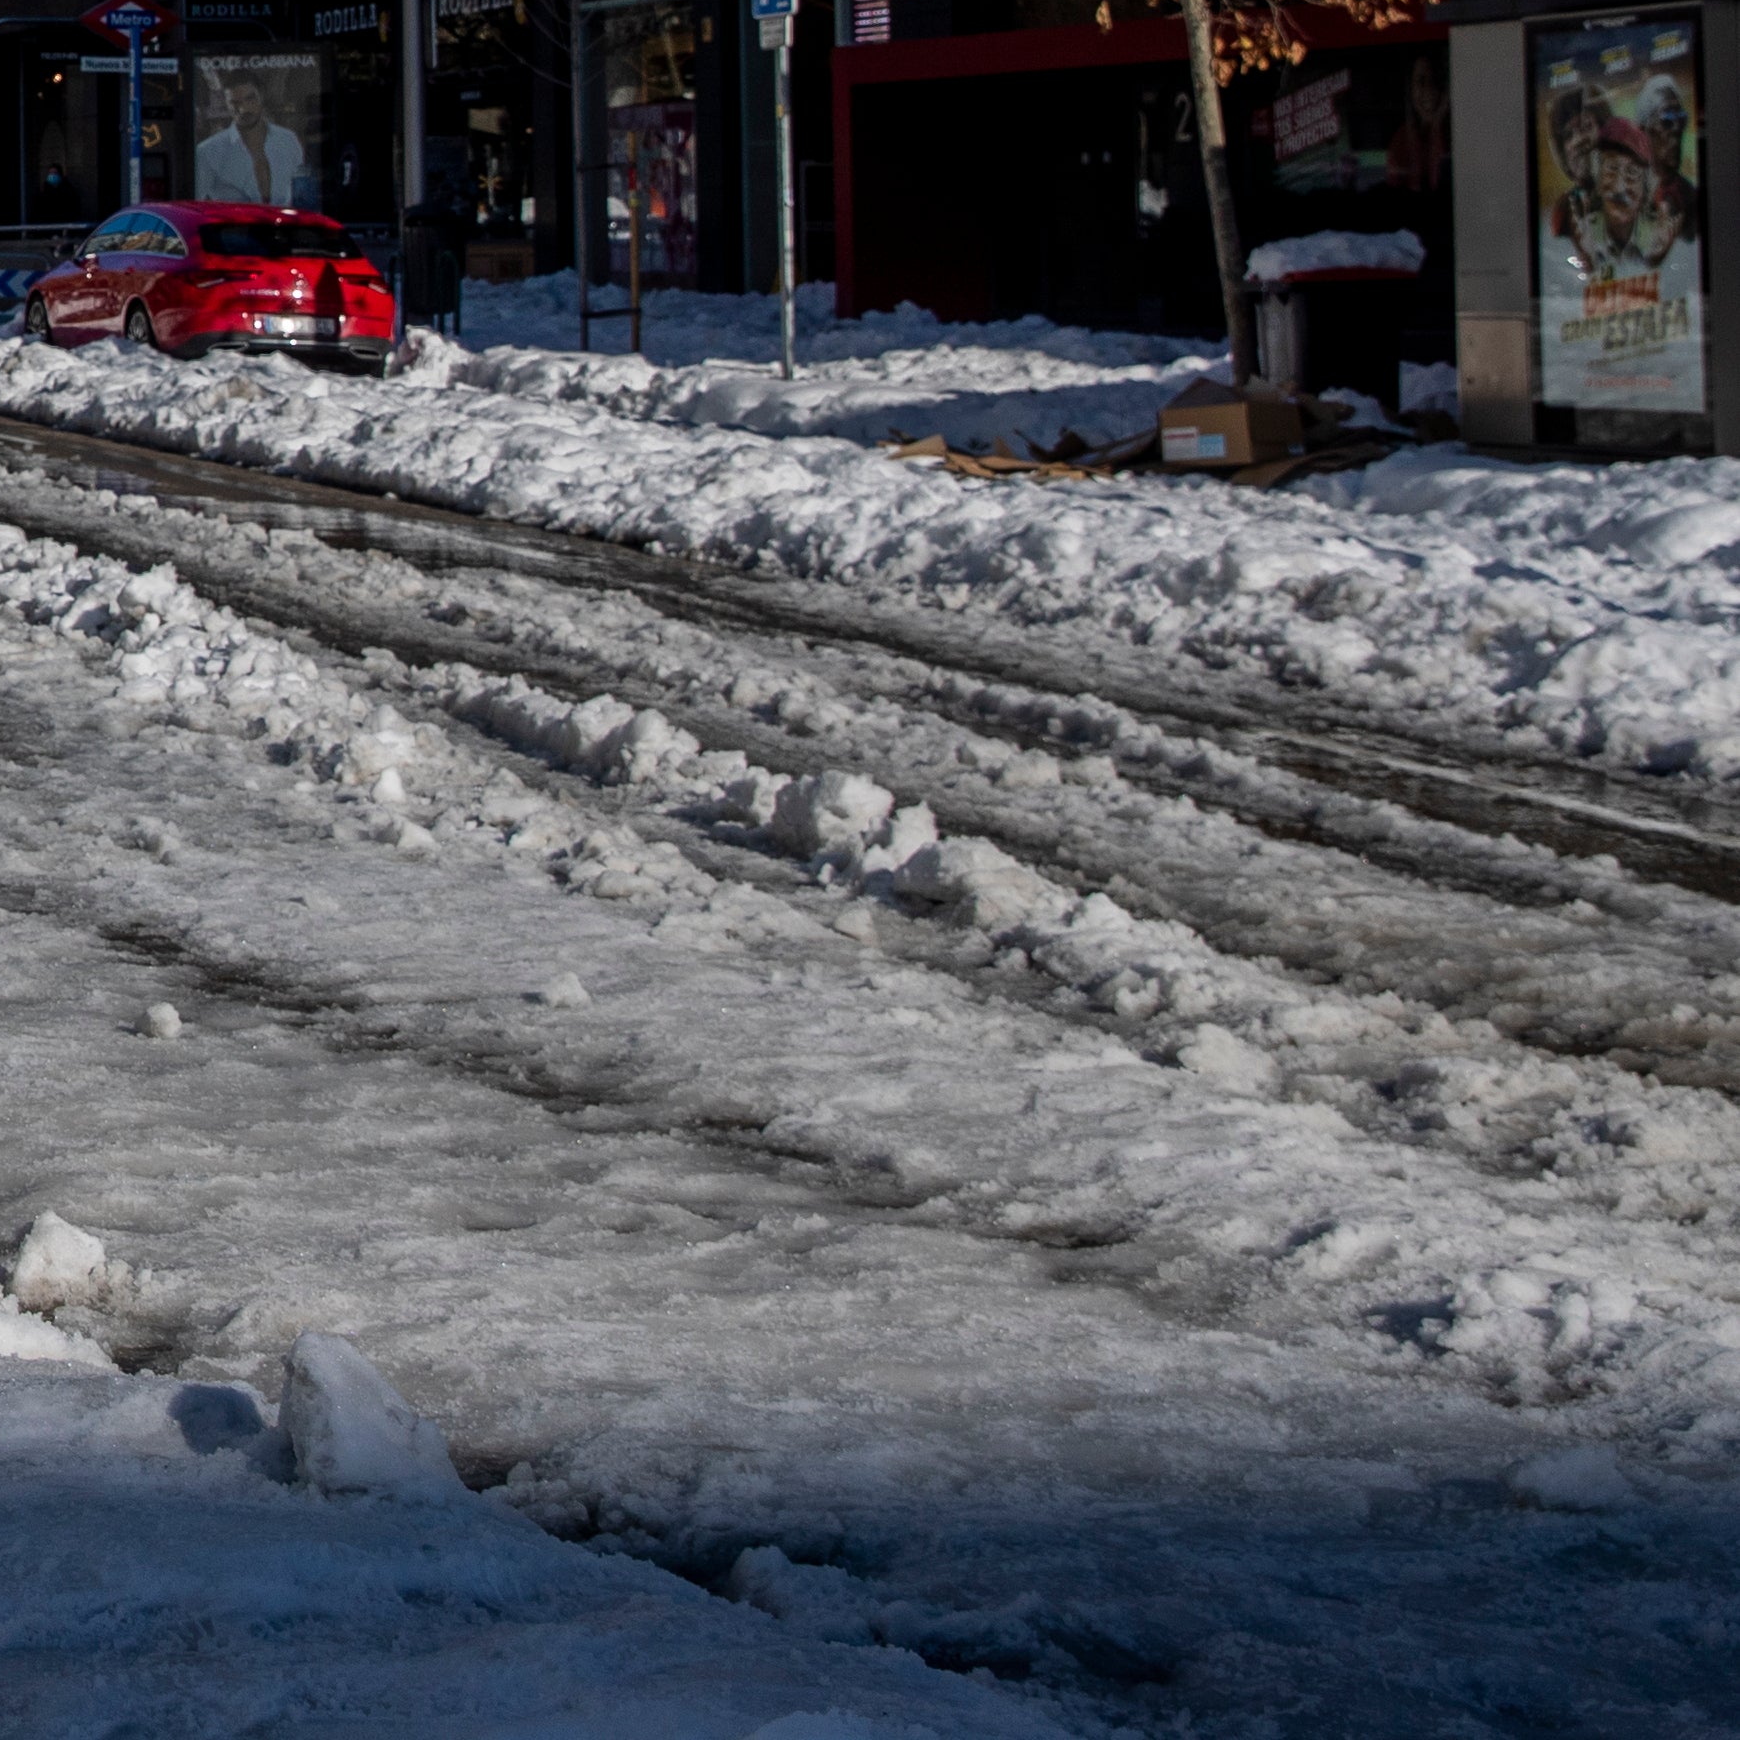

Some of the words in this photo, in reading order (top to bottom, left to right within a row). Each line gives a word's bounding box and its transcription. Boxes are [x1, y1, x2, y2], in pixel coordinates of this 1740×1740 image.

[191, 3, 273, 18] RODILLA
[109, 11, 154, 27] Metro
[313, 2, 380, 37] RODILLA
[84, 60, 121, 70] Nuevos
[123, 61, 175, 71] Msterios
[200, 56, 241, 71] DOLCE
[249, 55, 316, 69] GABBANA
[1603, 298, 1689, 351] ESTAFA
